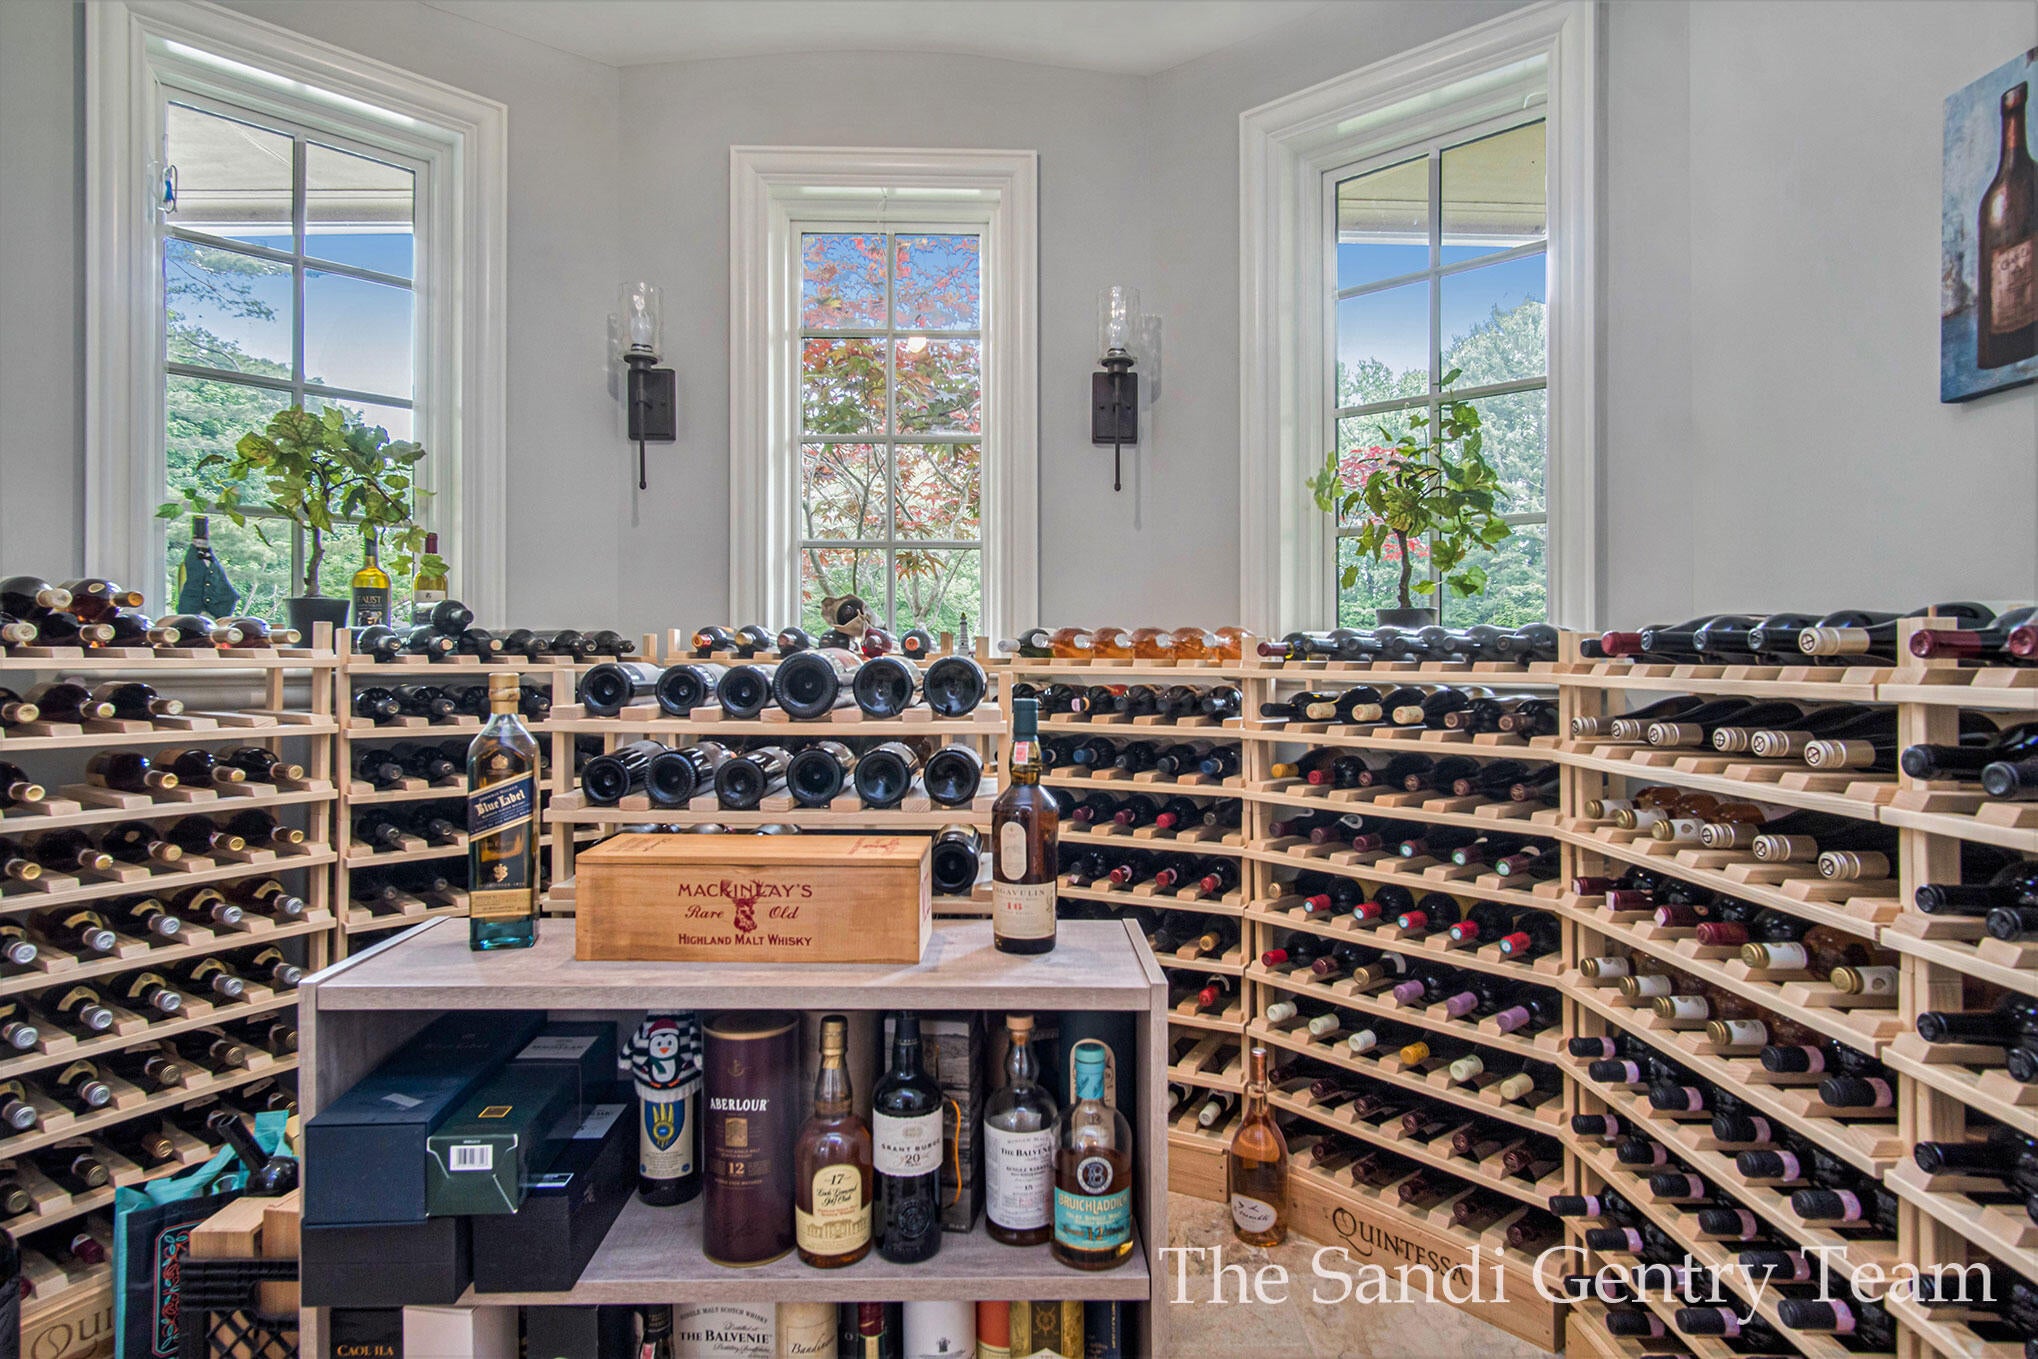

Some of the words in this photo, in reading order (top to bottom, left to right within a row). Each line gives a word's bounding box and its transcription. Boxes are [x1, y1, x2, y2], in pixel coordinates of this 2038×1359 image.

[474, 800, 500, 817] Blue
[498, 789, 526, 808] Label
[677, 880, 813, 899] MACKINLAY'S
[685, 904, 724, 920] Rare
[769, 904, 799, 920] Old
[678, 934, 732, 946] HIGHLAND
[735, 934, 764, 946] MALT
[767, 934, 812, 946] WHISKY
[710, 1097, 767, 1111] ABERLOUR
[905, 1153, 920, 1164] 20
[728, 1161, 745, 1175] 12
[831, 1173, 845, 1185] 17
[1332, 1207, 1469, 1286] QUINTESSA
[681, 1331, 702, 1341] THE
[705, 1329, 769, 1344] BALVENIE
[337, 1344, 369, 1356] CAOL
[374, 1345, 394, 1356] ILA
